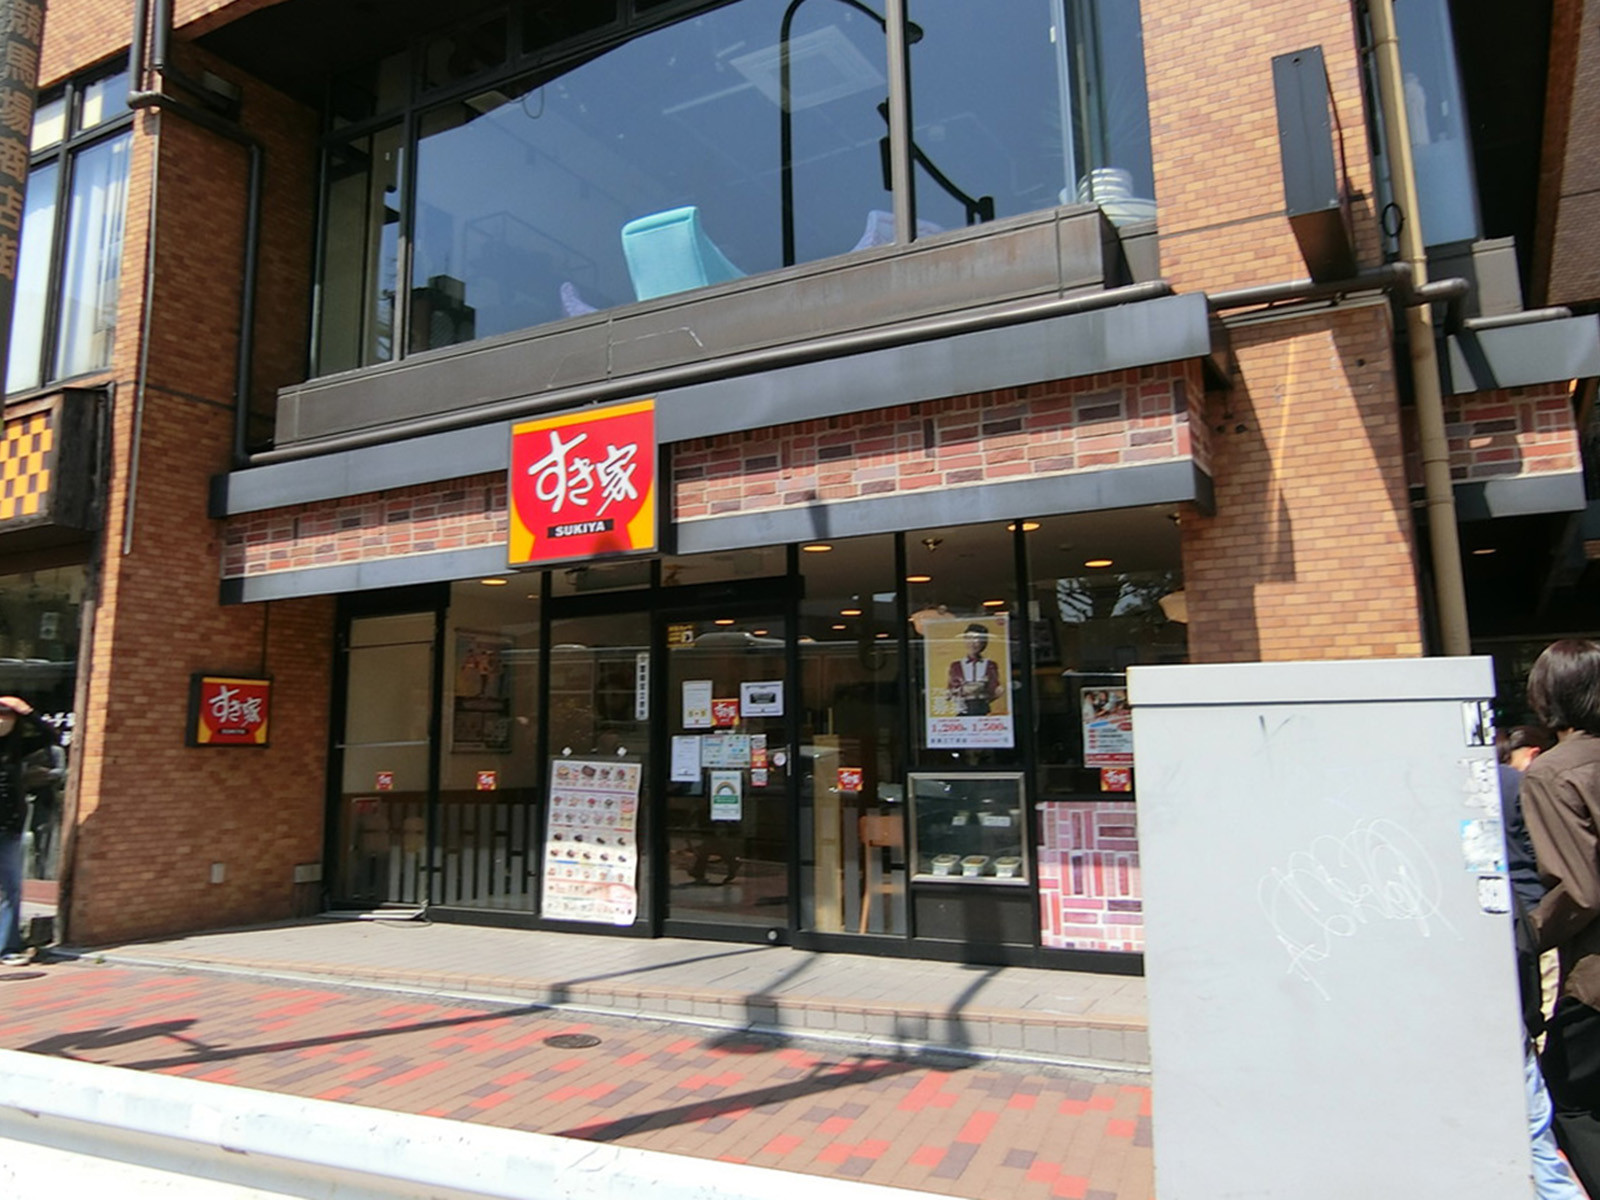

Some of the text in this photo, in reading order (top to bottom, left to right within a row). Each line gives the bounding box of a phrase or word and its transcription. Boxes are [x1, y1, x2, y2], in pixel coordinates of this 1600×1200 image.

[528, 431, 638, 516] すき家
[554, 521, 606, 537] SUKIYA
[208, 685, 263, 728] すき家
